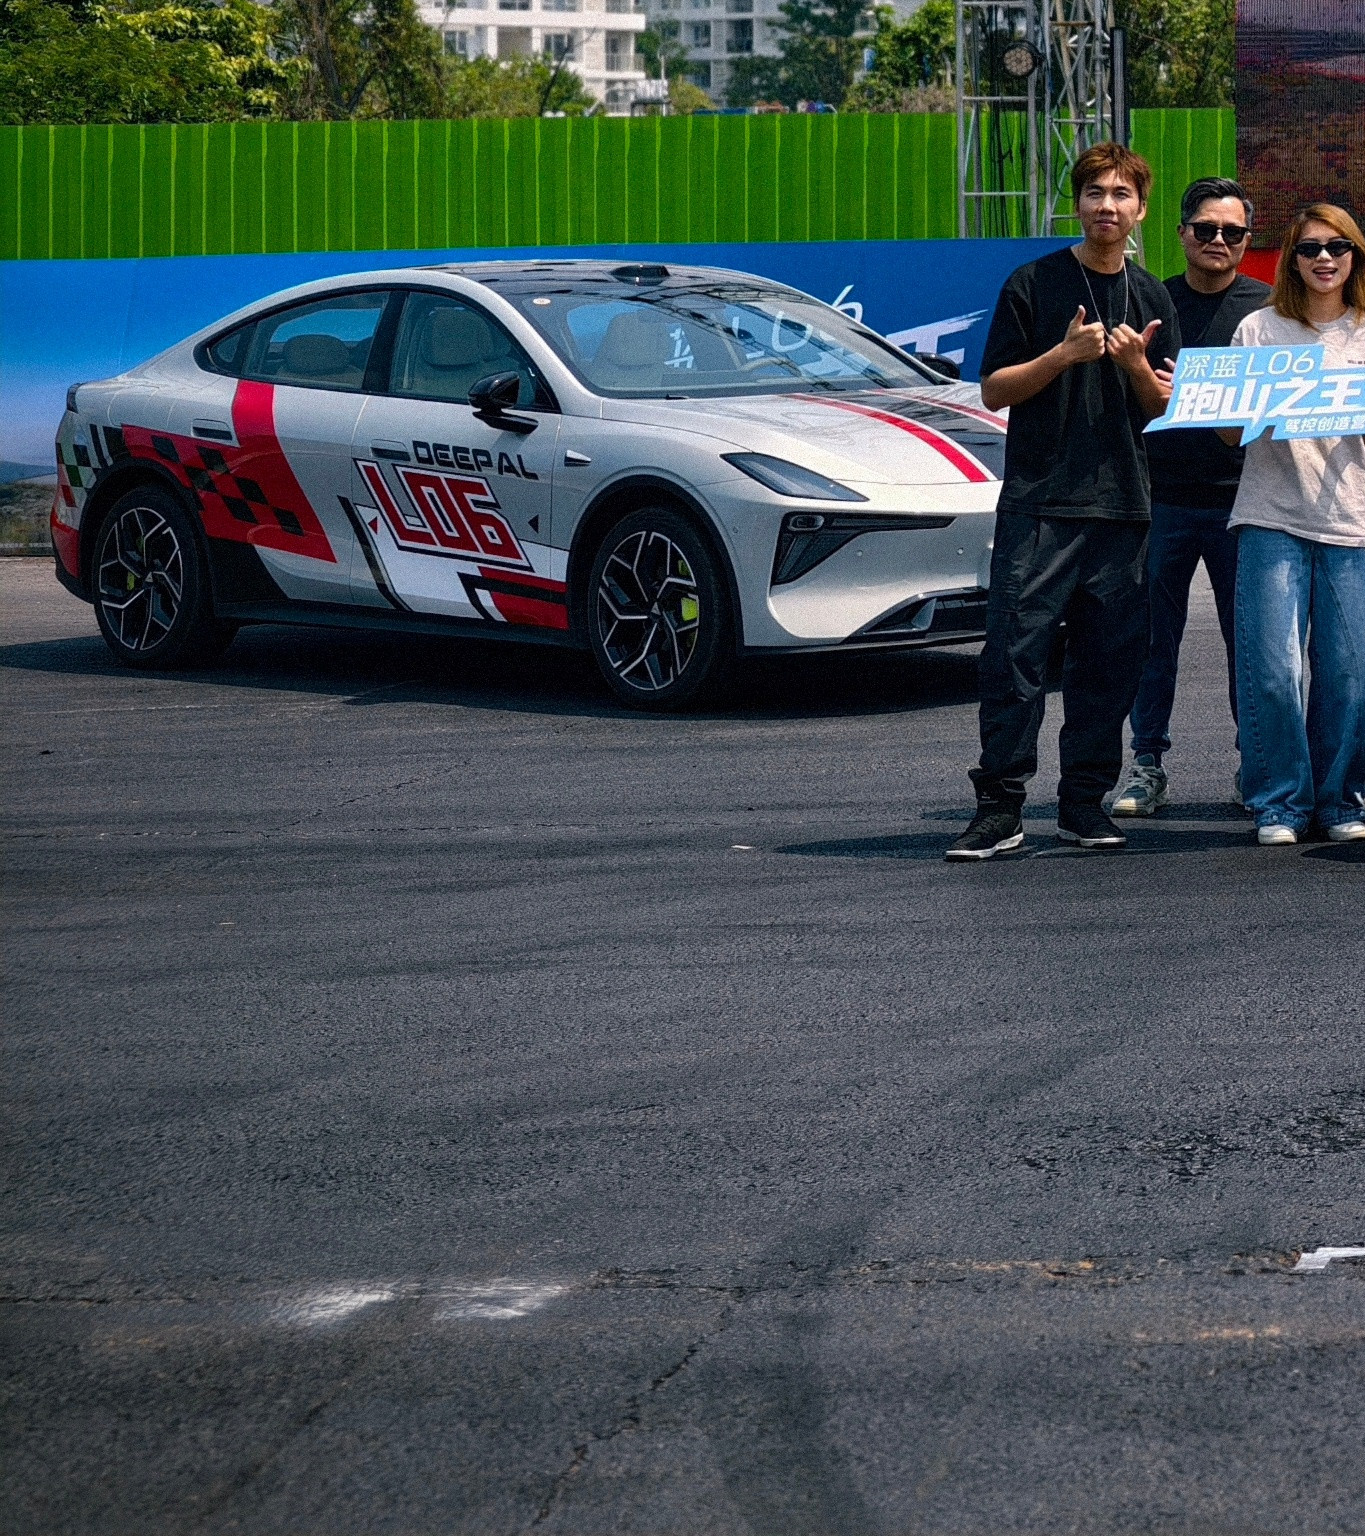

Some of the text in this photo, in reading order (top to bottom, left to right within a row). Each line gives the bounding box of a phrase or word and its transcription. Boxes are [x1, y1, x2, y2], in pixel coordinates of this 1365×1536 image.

[1180, 350, 1314, 380] 深蓝L06
[412, 440, 539, 480] DEEPAL
[354, 459, 533, 572] L06
